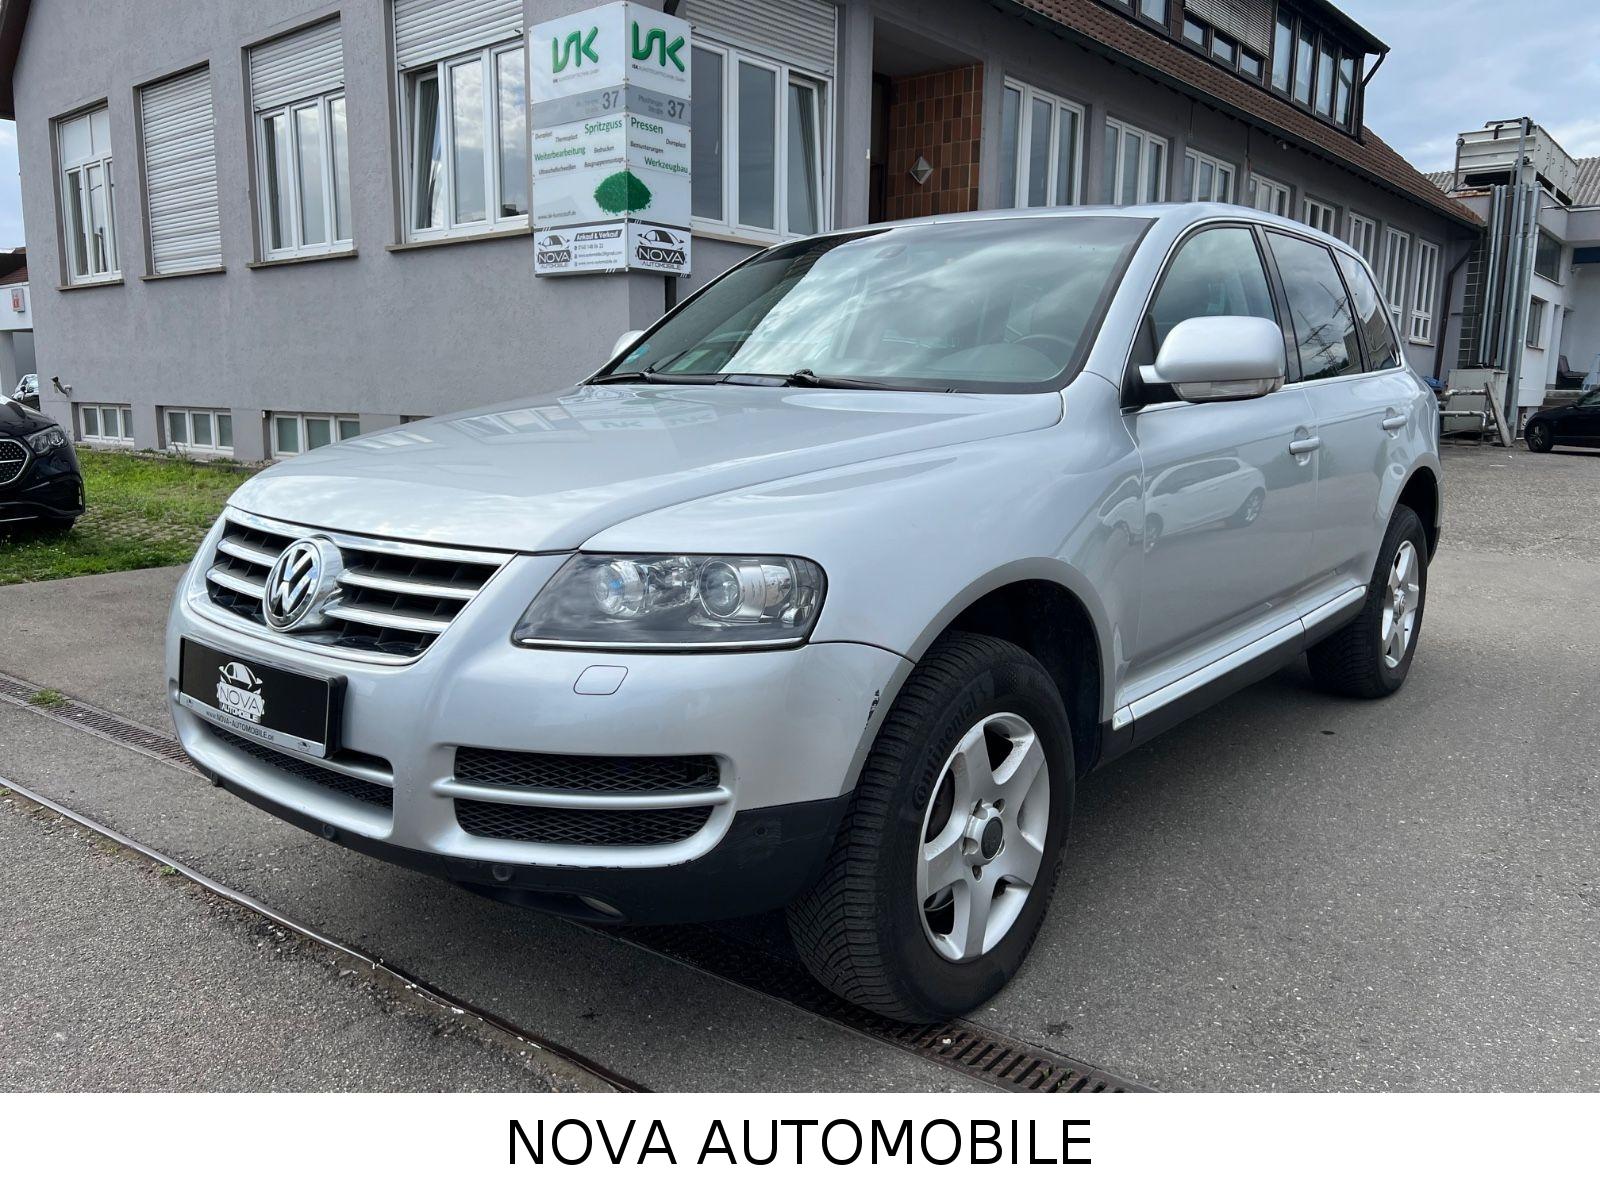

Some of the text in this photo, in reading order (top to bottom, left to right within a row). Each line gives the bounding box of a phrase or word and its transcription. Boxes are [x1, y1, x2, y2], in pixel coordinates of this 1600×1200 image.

[602, 91, 619, 110] 37
[667, 99, 685, 120] 37
[584, 120, 623, 135] Spritzguss
[630, 117, 664, 135] Pressen
[534, 146, 586, 161] Weiterbearbeitung
[644, 156, 689, 174] Werkzeugbau
[599, 230, 619, 239] Verkauf
[538, 251, 570, 264] NOVA
[639, 247, 684, 264] NOVA
[219, 685, 262, 715] NOVA
